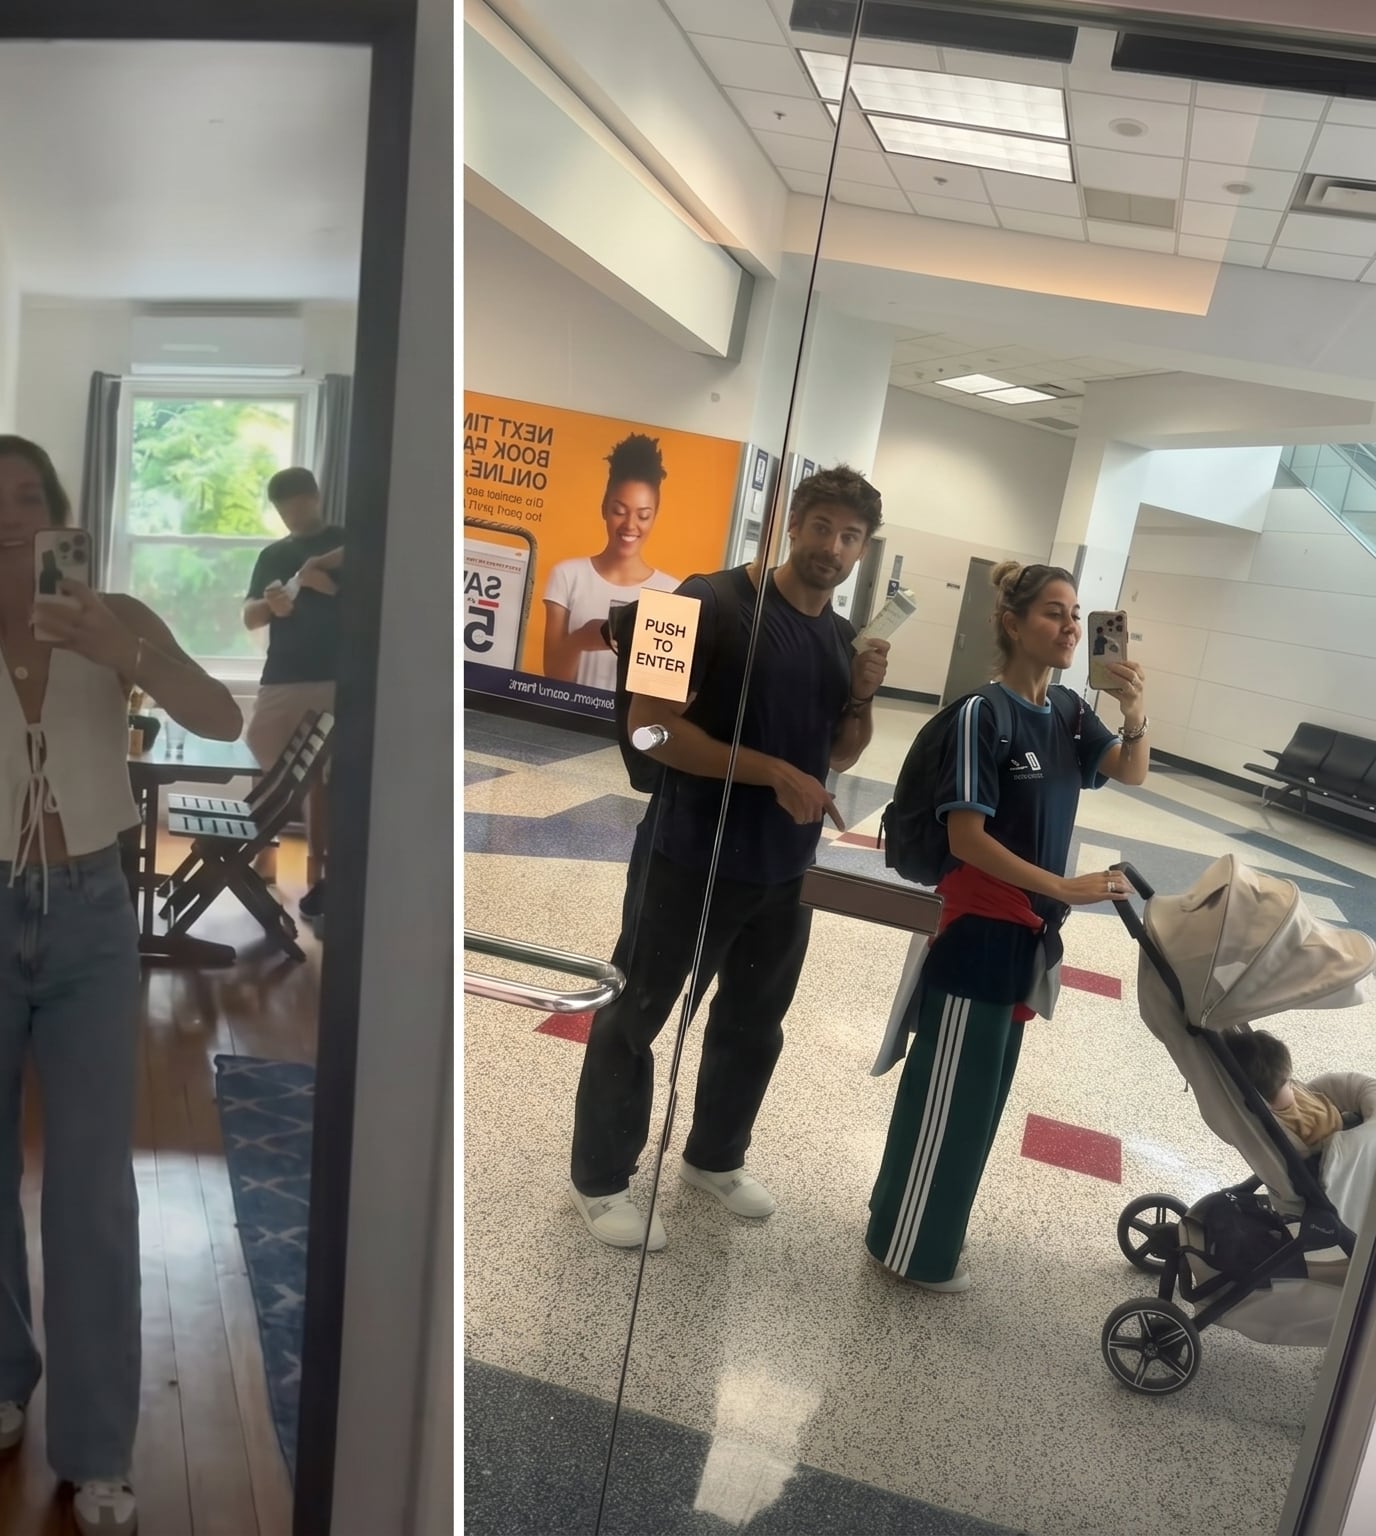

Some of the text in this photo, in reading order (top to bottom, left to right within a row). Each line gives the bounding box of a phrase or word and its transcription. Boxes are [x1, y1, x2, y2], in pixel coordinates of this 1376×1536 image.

[645, 618, 686, 638] PUSH
[653, 637, 673, 653] TO
[636, 651, 685, 674] ENTER
